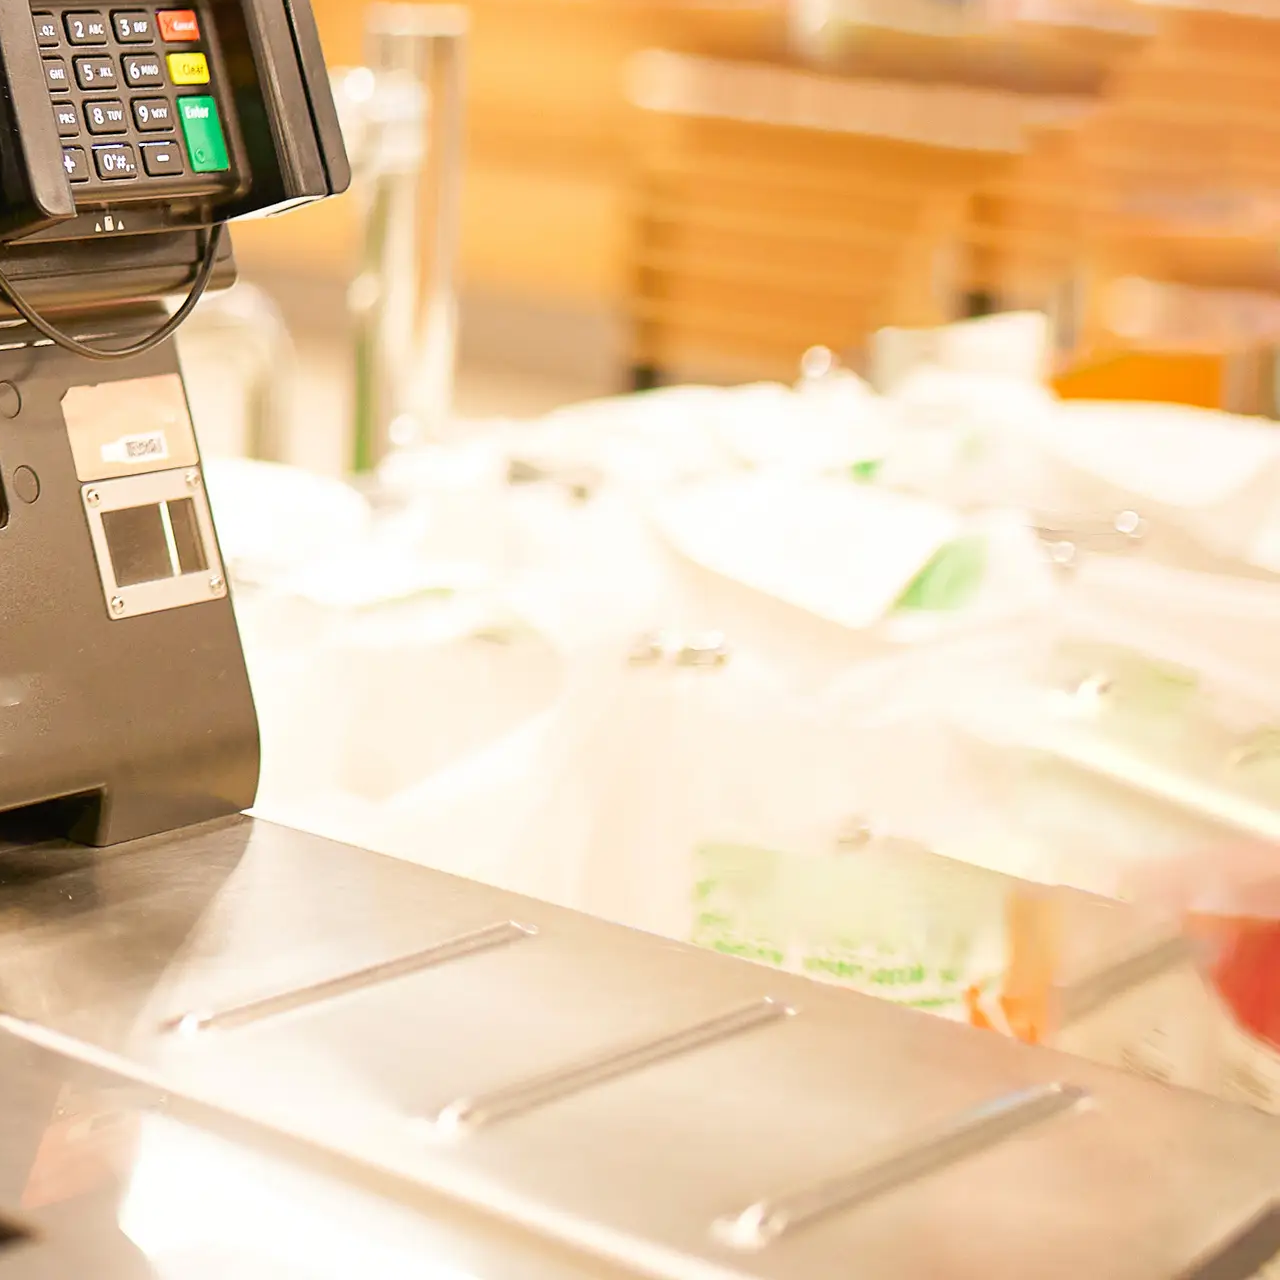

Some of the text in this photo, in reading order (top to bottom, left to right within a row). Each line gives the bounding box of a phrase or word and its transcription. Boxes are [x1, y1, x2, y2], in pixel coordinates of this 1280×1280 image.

[74, 21, 104, 37] 2 ABC
[120, 19, 147, 36] 3 DEF
[49, 69, 65, 80] GHI
[83, 64, 113, 81] 5 JKL
[130, 62, 159, 79] 6 MNO
[59, 114, 76, 124] PRS
[93, 108, 122, 124] 8 TUV
[138, 105, 167, 123] 9 WXY
[184, 105, 209, 119] Enter
